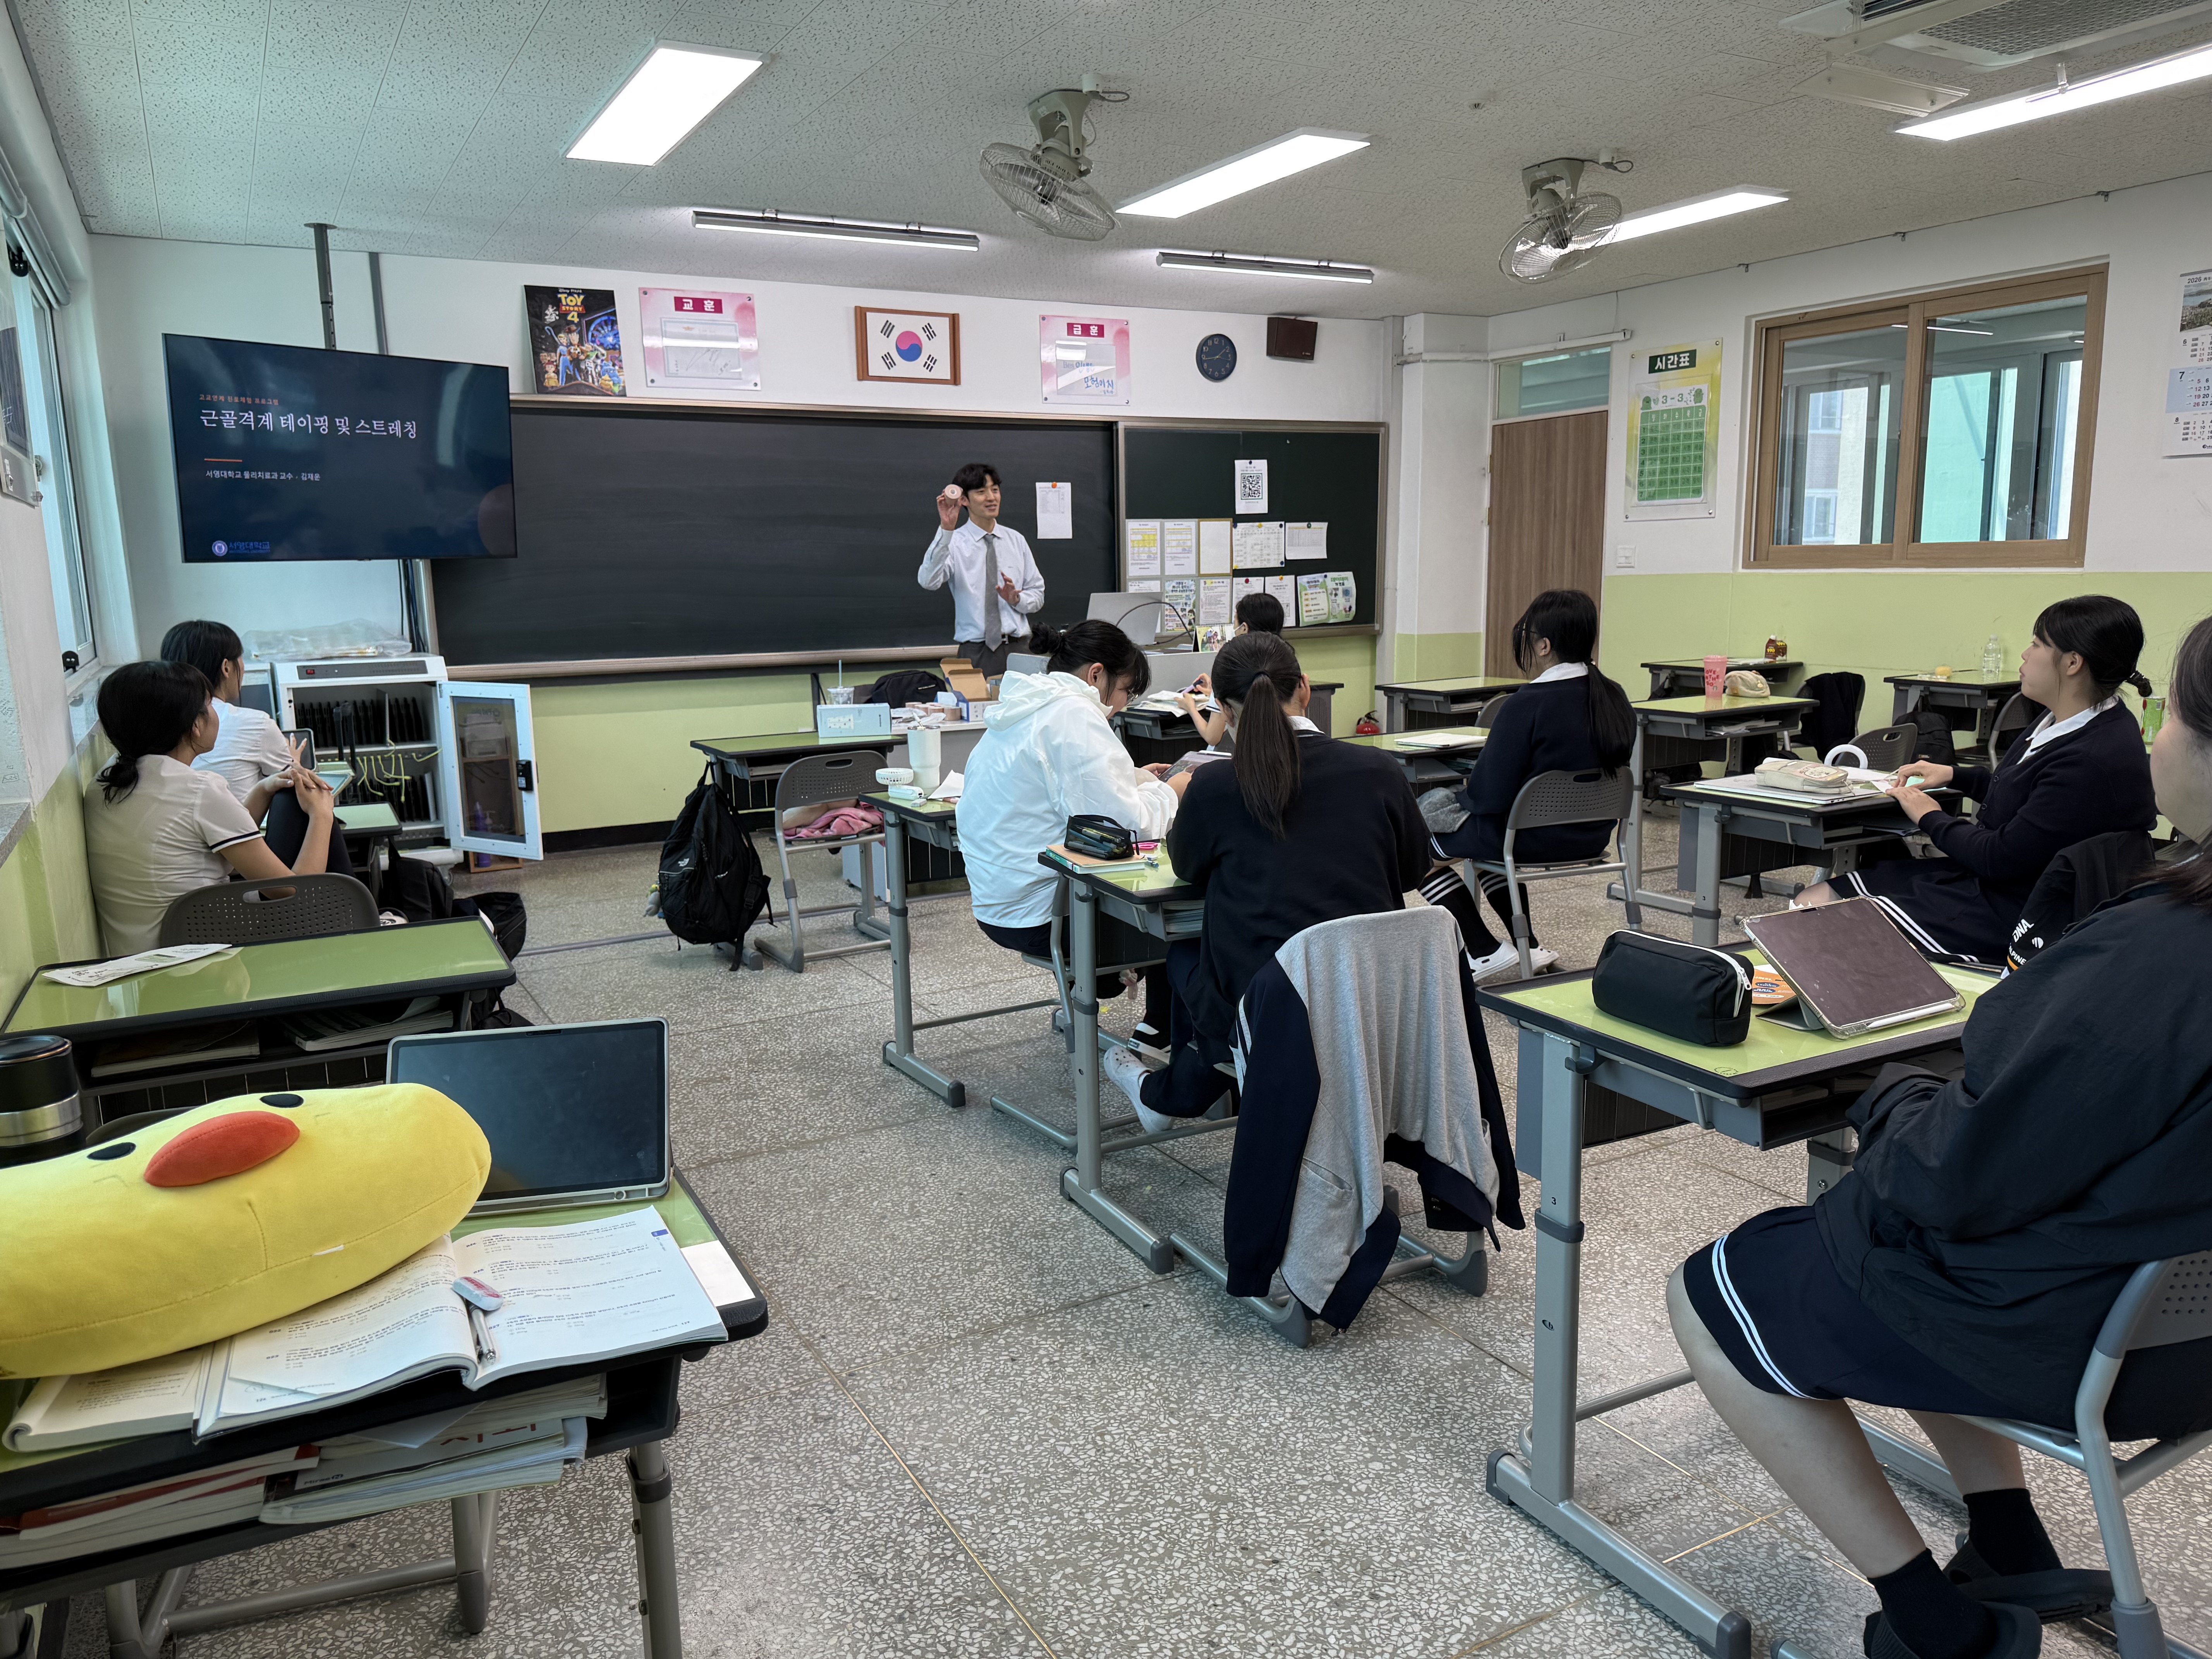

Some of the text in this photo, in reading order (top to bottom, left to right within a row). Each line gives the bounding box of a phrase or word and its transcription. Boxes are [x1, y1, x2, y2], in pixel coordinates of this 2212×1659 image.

[558, 294, 585, 306] TOY
[567, 311, 579, 323] 4
[1654, 353, 1690, 370] 시간표
[2179, 371, 2185, 380] 7
[200, 409, 416, 439] 근골격계 테이핑 및 스트레칭
[206, 470, 242, 478] 서영대학교
[243, 471, 278, 479] 물리치료과
[279, 472, 293, 480] 교수
[2012, 919, 2035, 943] DNA
